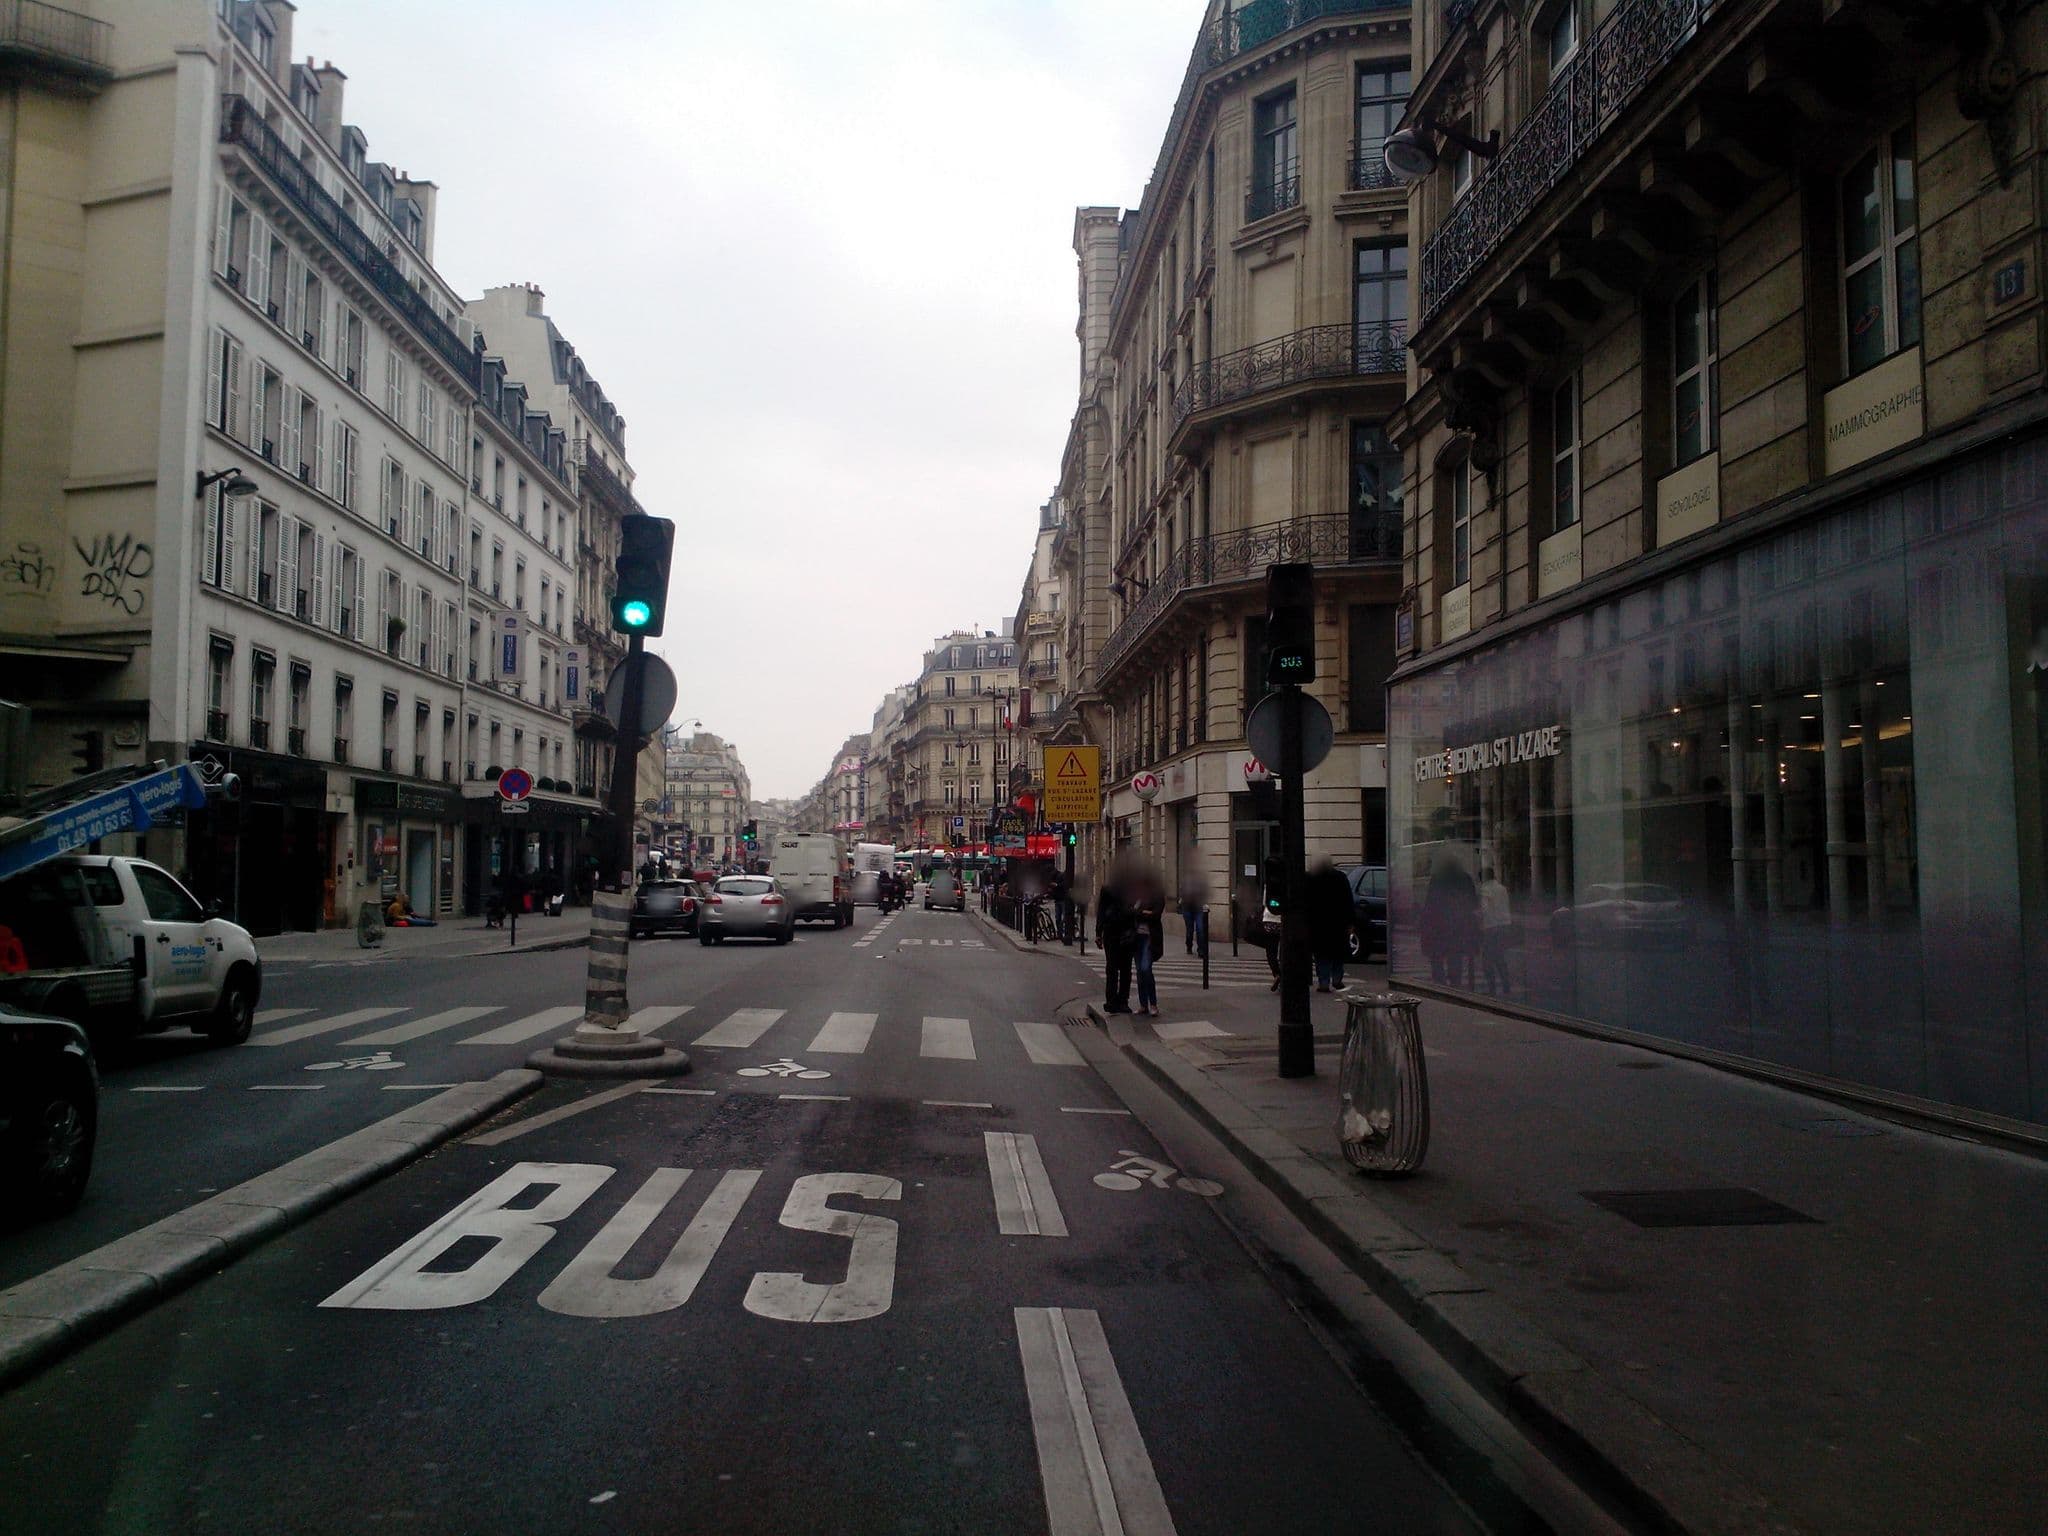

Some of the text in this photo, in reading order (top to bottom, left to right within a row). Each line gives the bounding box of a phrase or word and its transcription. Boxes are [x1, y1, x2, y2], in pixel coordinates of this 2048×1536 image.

[2000, 268, 2017, 298] 13
[1828, 385, 1924, 443] MAMMOGRAPHIE
[1415, 751, 1449, 782] CENTRE
[1493, 737, 1509, 769] ST
[1509, 725, 1562, 764] LAZARE
[89, 821, 104, 838] 40
[105, 815, 119, 832] 63
[317, 1161, 904, 1324] BUS
